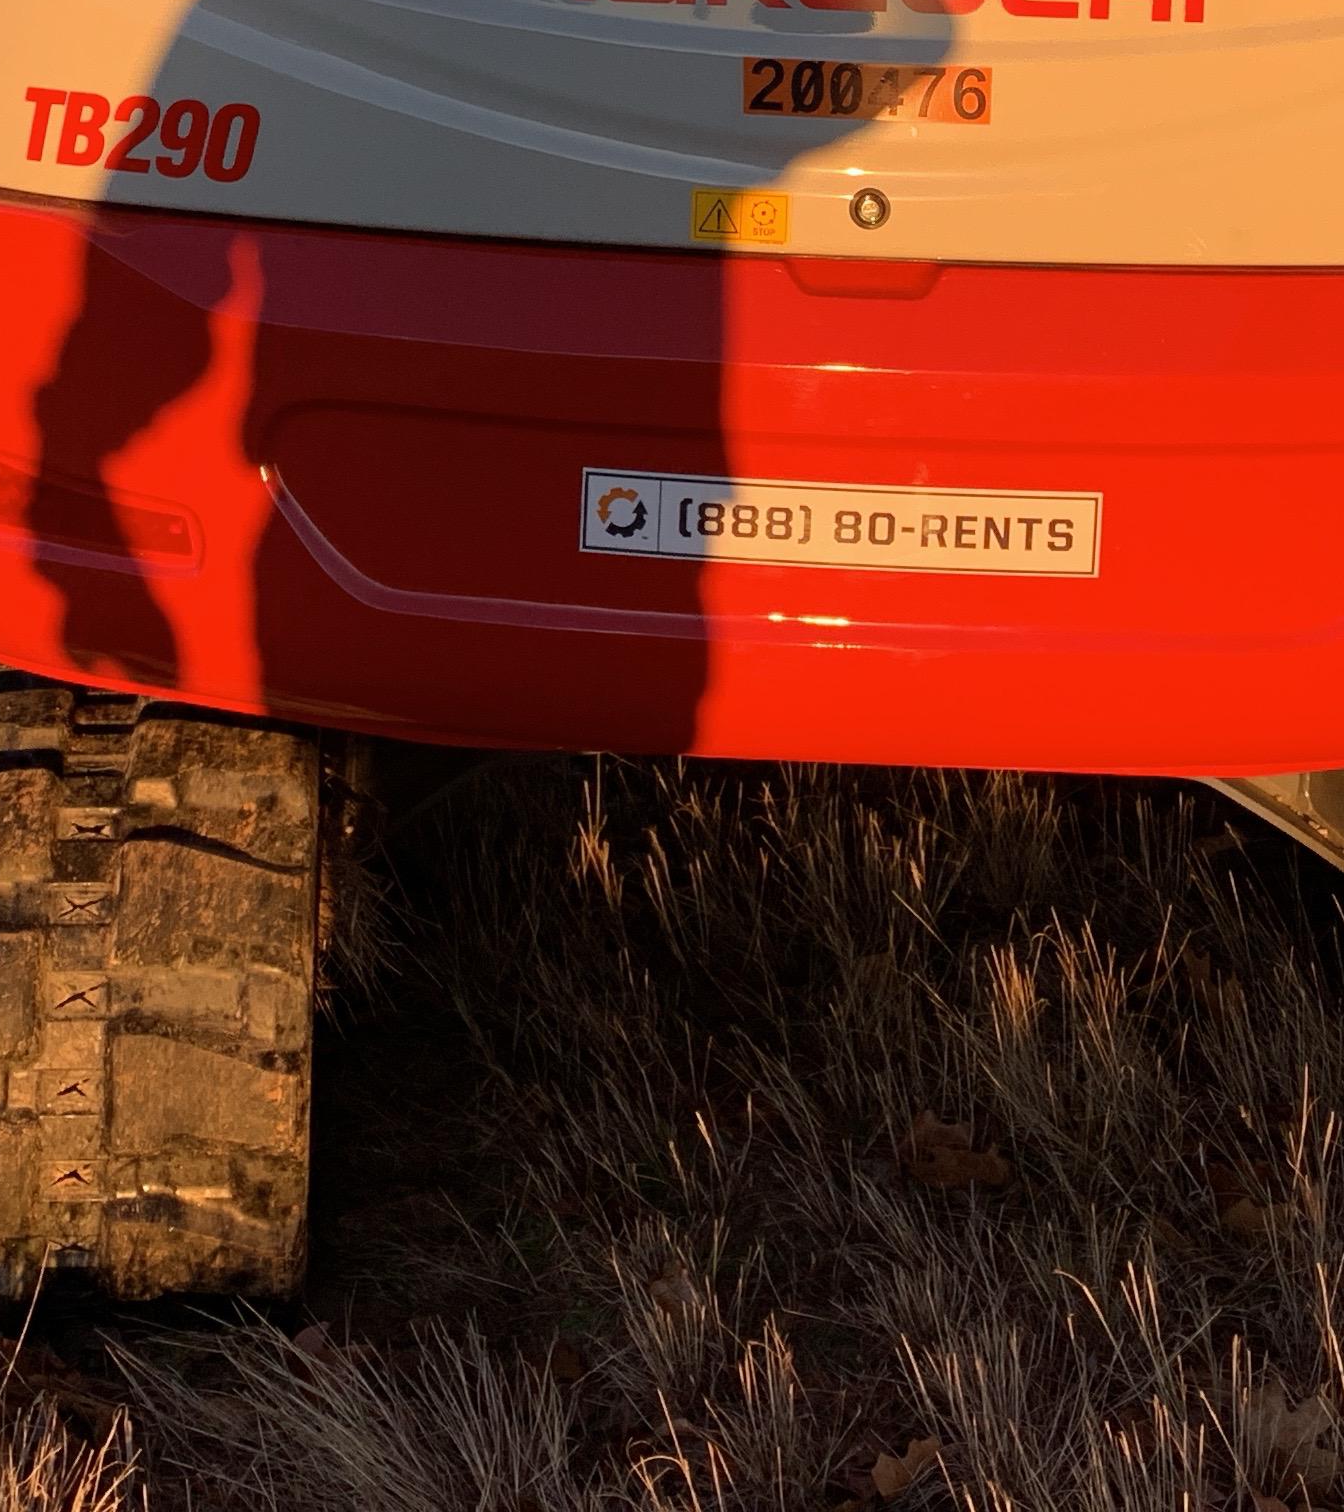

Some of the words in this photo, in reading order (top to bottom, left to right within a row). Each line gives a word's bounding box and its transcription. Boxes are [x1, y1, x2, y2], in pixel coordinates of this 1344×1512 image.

[748, 58, 987, 120] 200476
[25, 86, 262, 183] TB290
[752, 227, 775, 237] STOP
[678, 498, 812, 545] (888)
[833, 509, 1075, 552] 80-RENTS
